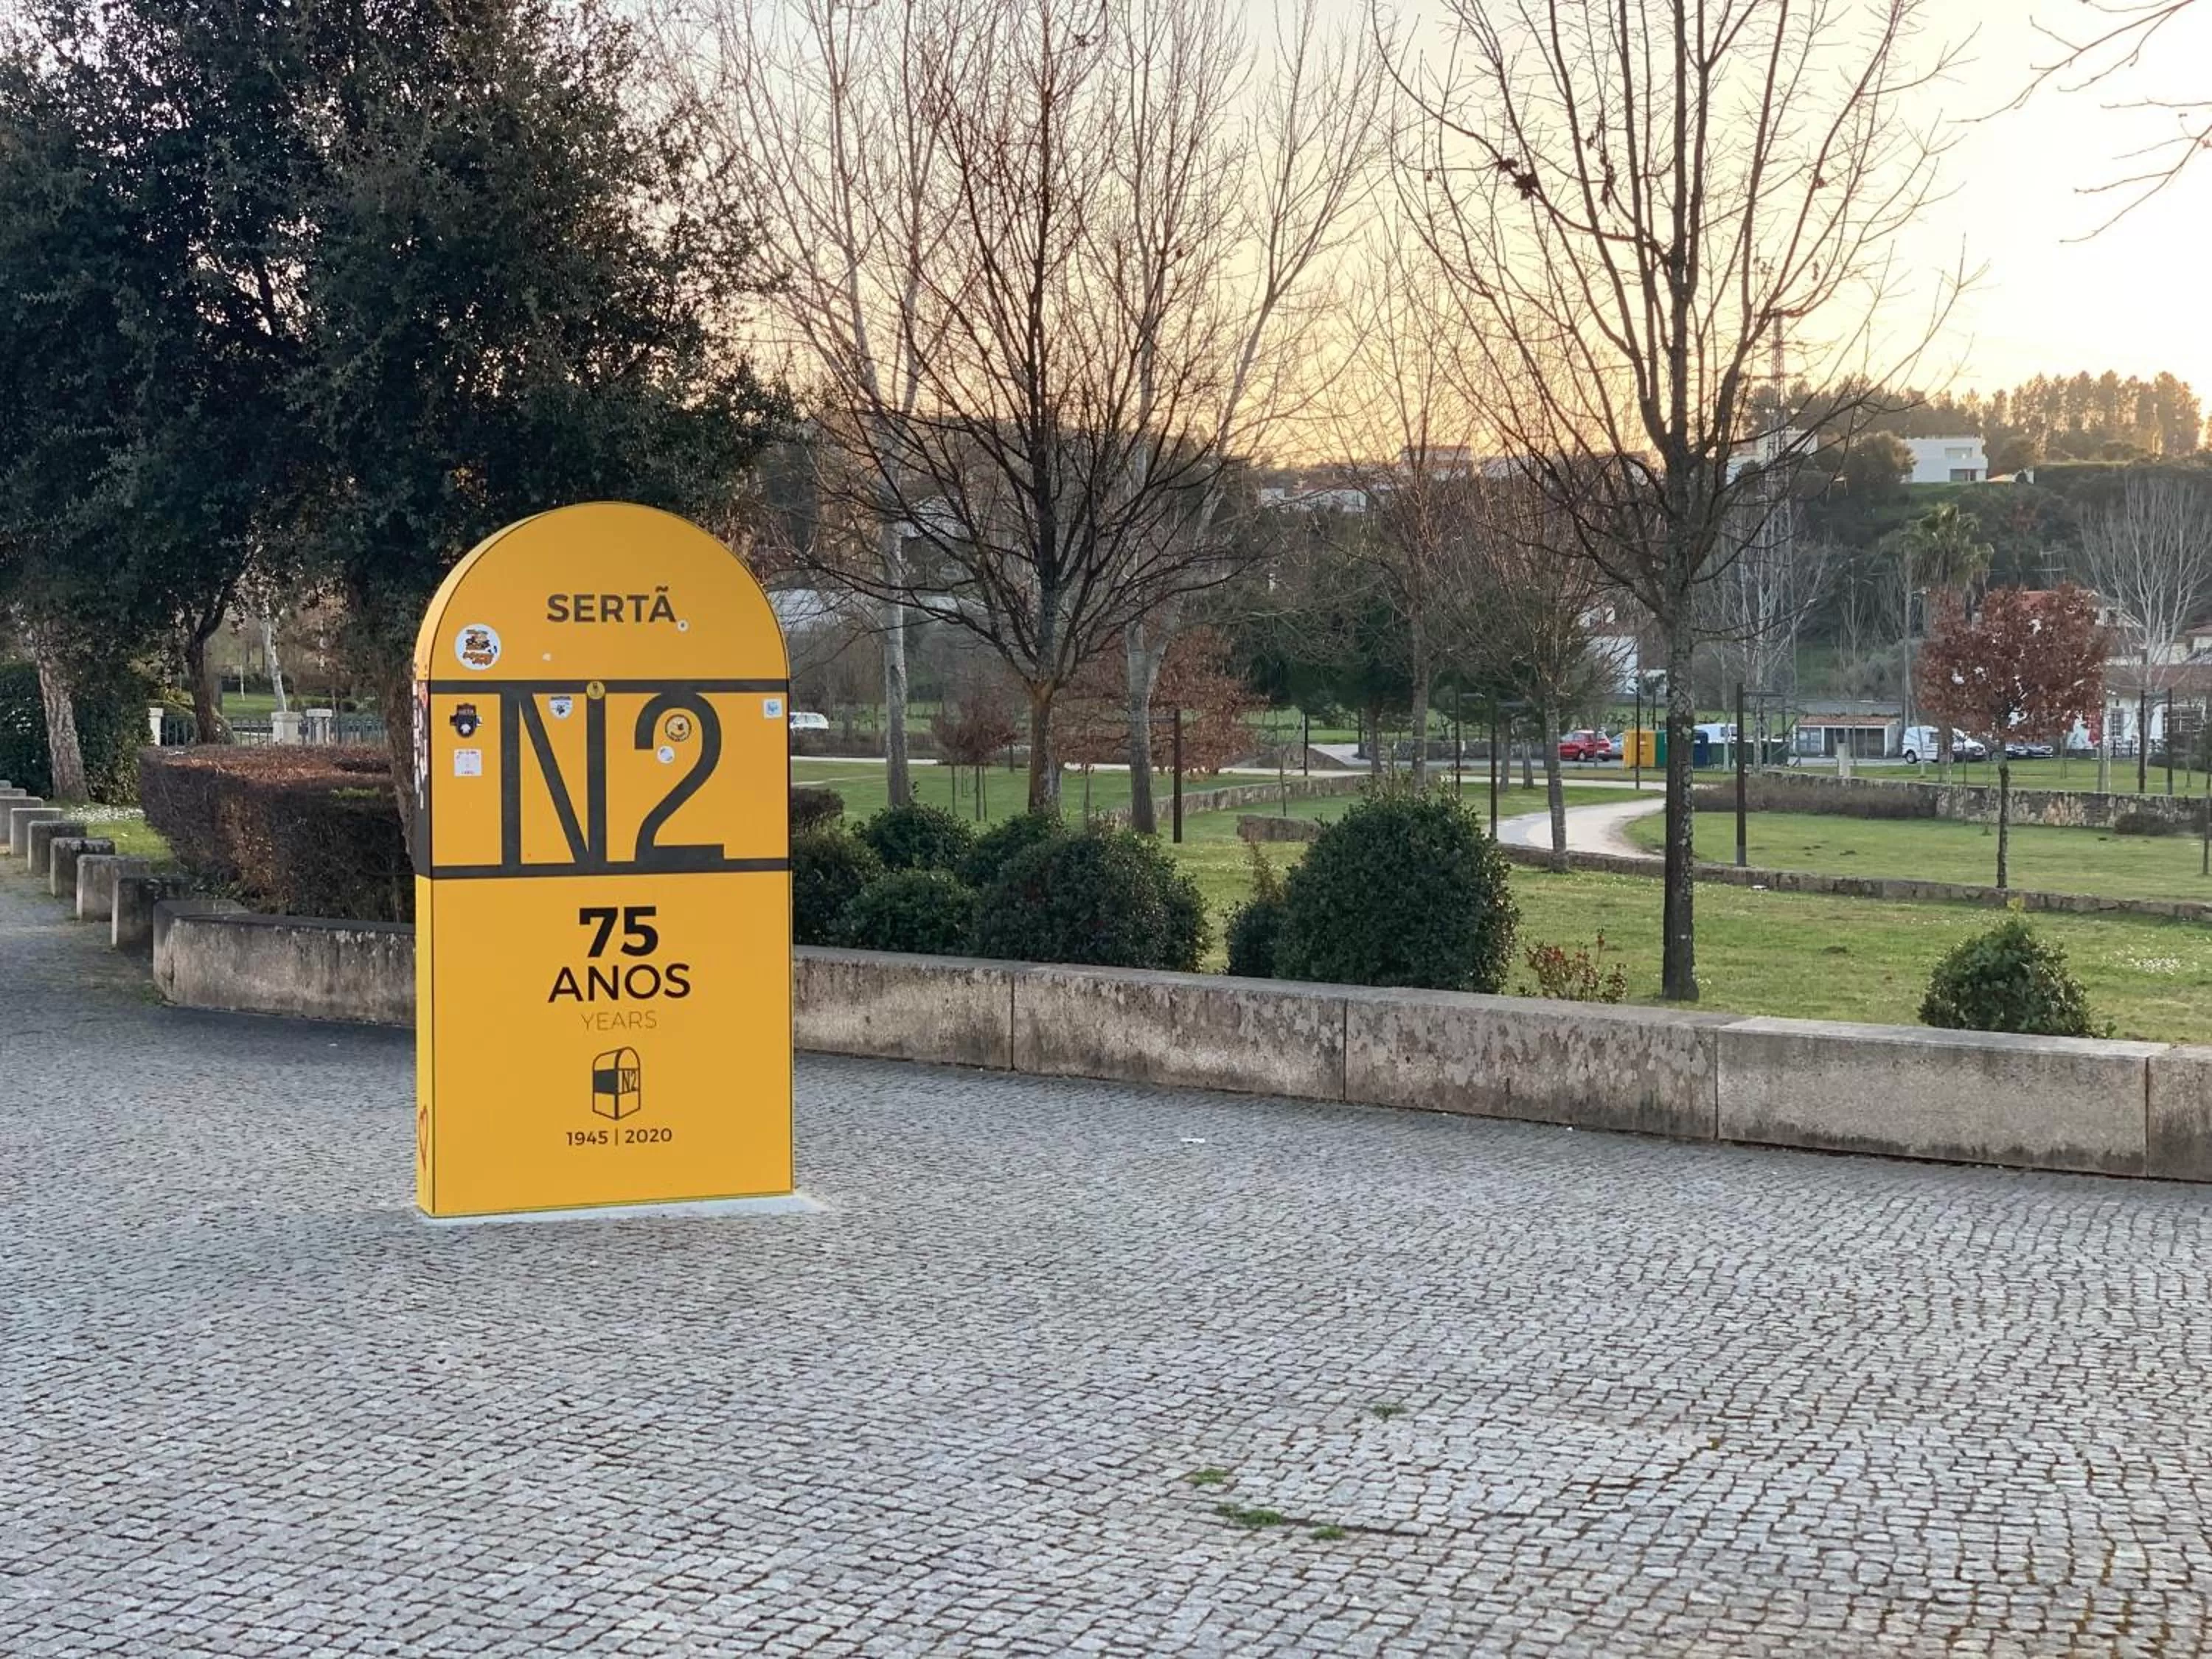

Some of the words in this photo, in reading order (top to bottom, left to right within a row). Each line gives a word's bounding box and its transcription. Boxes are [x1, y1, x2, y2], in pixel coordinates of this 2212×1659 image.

[546, 586, 676, 623] SERTÃ
[500, 681, 726, 874] N2
[579, 906, 658, 957] 75
[548, 963, 691, 1003] ANOS
[581, 1011, 657, 1031] YEARS
[622, 1069, 639, 1093] N2
[566, 1131, 608, 1146] 1945
[625, 1128, 672, 1144] 2020
